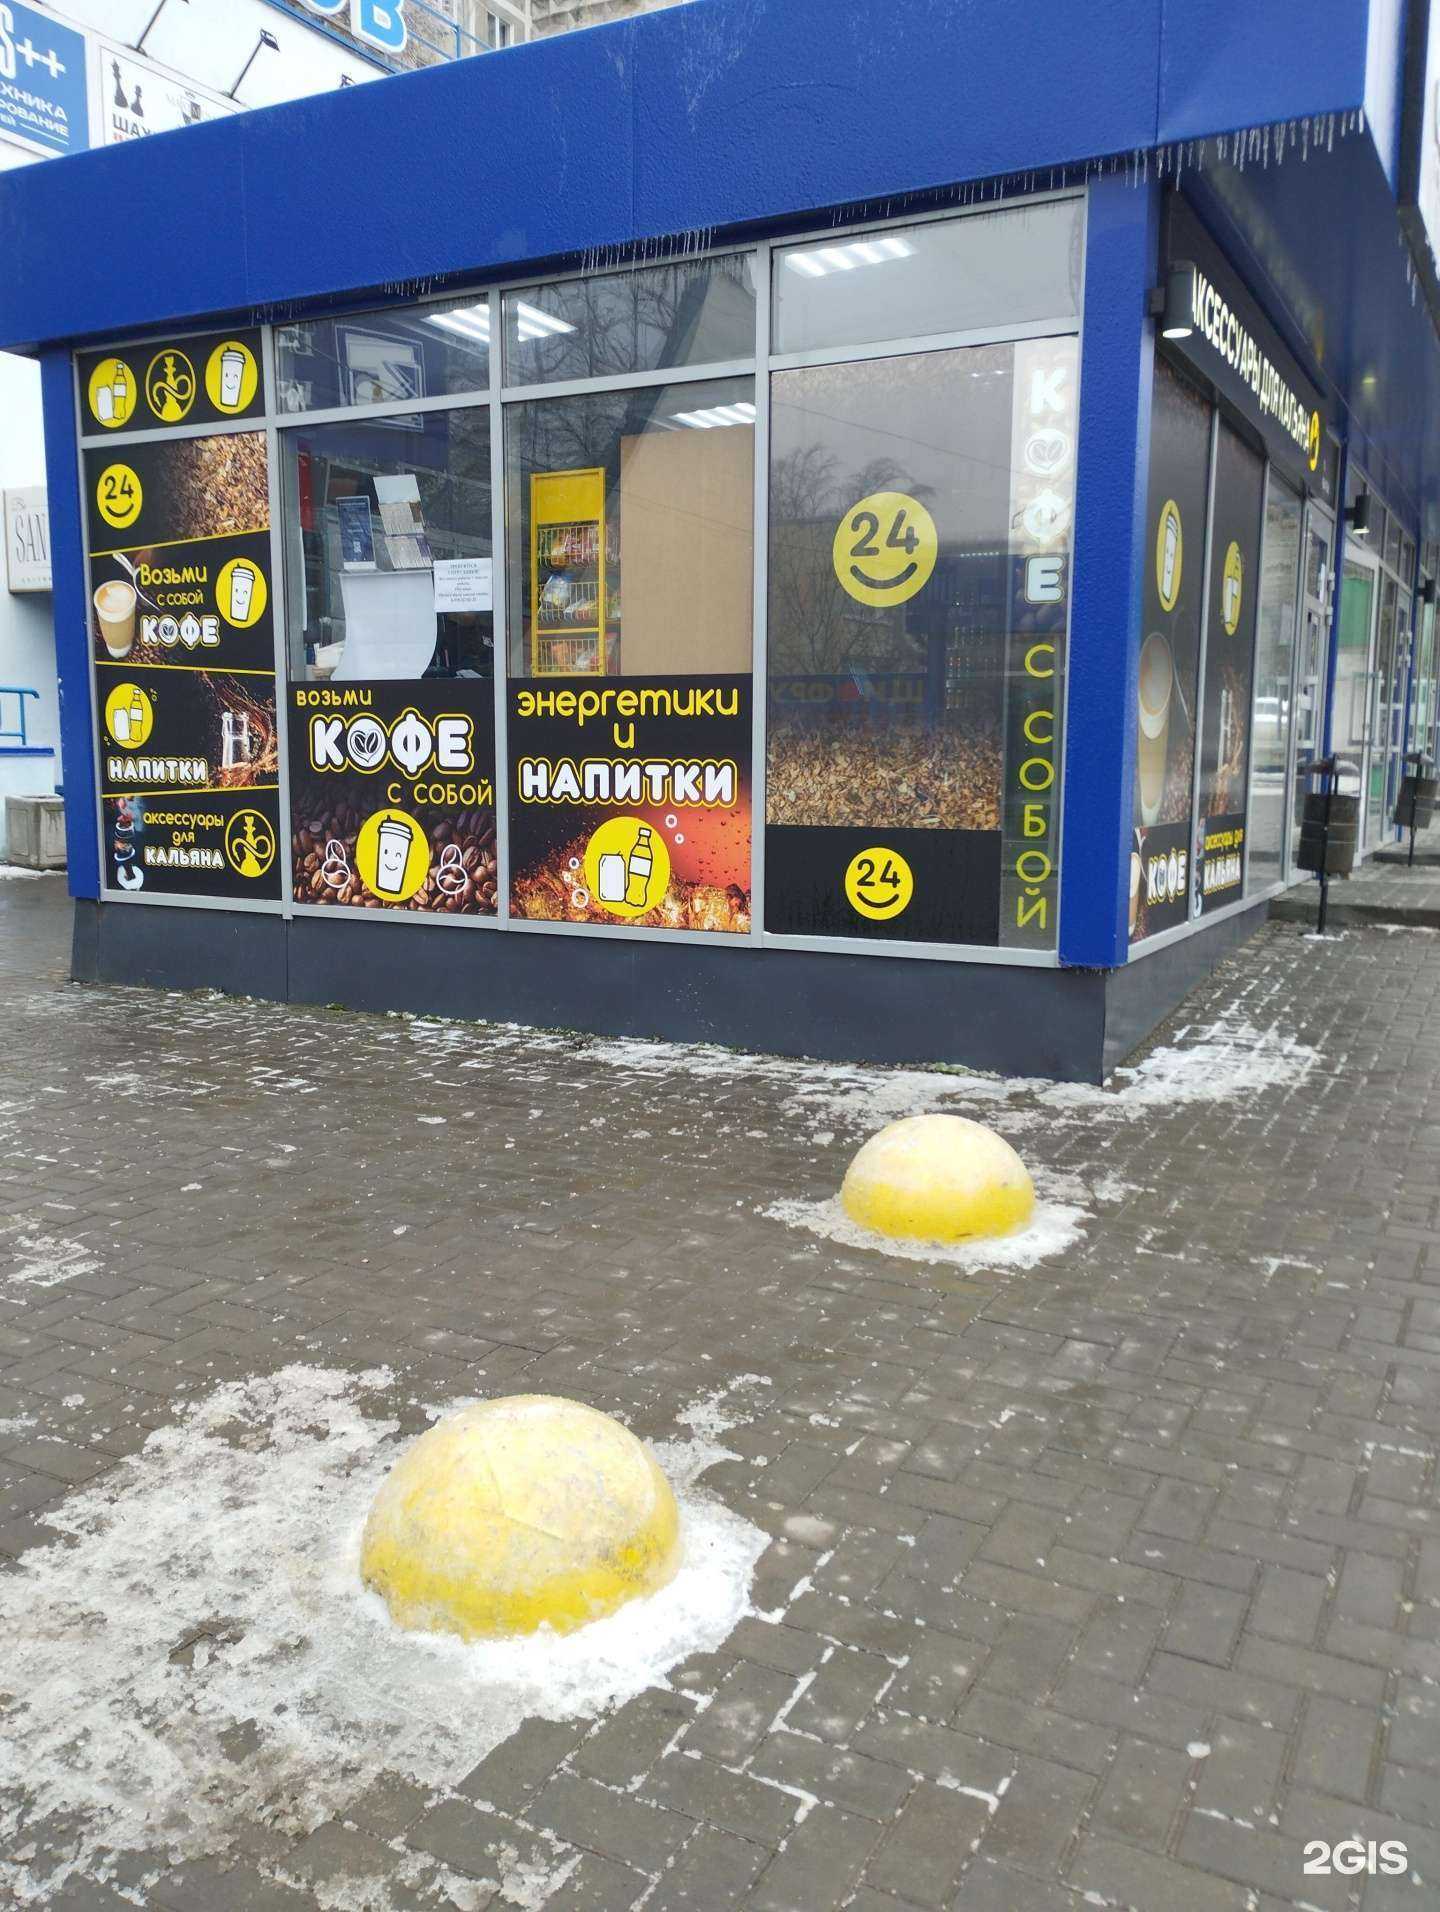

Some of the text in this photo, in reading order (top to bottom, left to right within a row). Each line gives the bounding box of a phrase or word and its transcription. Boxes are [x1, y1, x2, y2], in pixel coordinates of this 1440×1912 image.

[104, 475, 135, 501] 24
[1024, 366, 1071, 605] КОФЕ
[849, 508, 921, 557] 24
[140, 562, 208, 586] Возьми
[167, 588, 204, 605] собой
[141, 614, 220, 649] КОФЕ
[295, 688, 373, 708] возьми
[517, 688, 739, 727] энергетики
[310, 709, 474, 779] КОФЕ
[613, 722, 635, 749] и
[107, 756, 208, 784] НАПИТКИ
[519, 757, 737, 807] НАПИТКИ
[414, 779, 493, 806] СОБОЙ
[143, 811, 225, 829] аксессуары
[1016, 709, 1056, 931] СОБОЙ
[171, 828, 195, 844] для
[143, 845, 225, 869] КАЛЬЯНА
[856, 857, 902, 888] 24
[1147, 848, 1187, 906] КОФЕ
